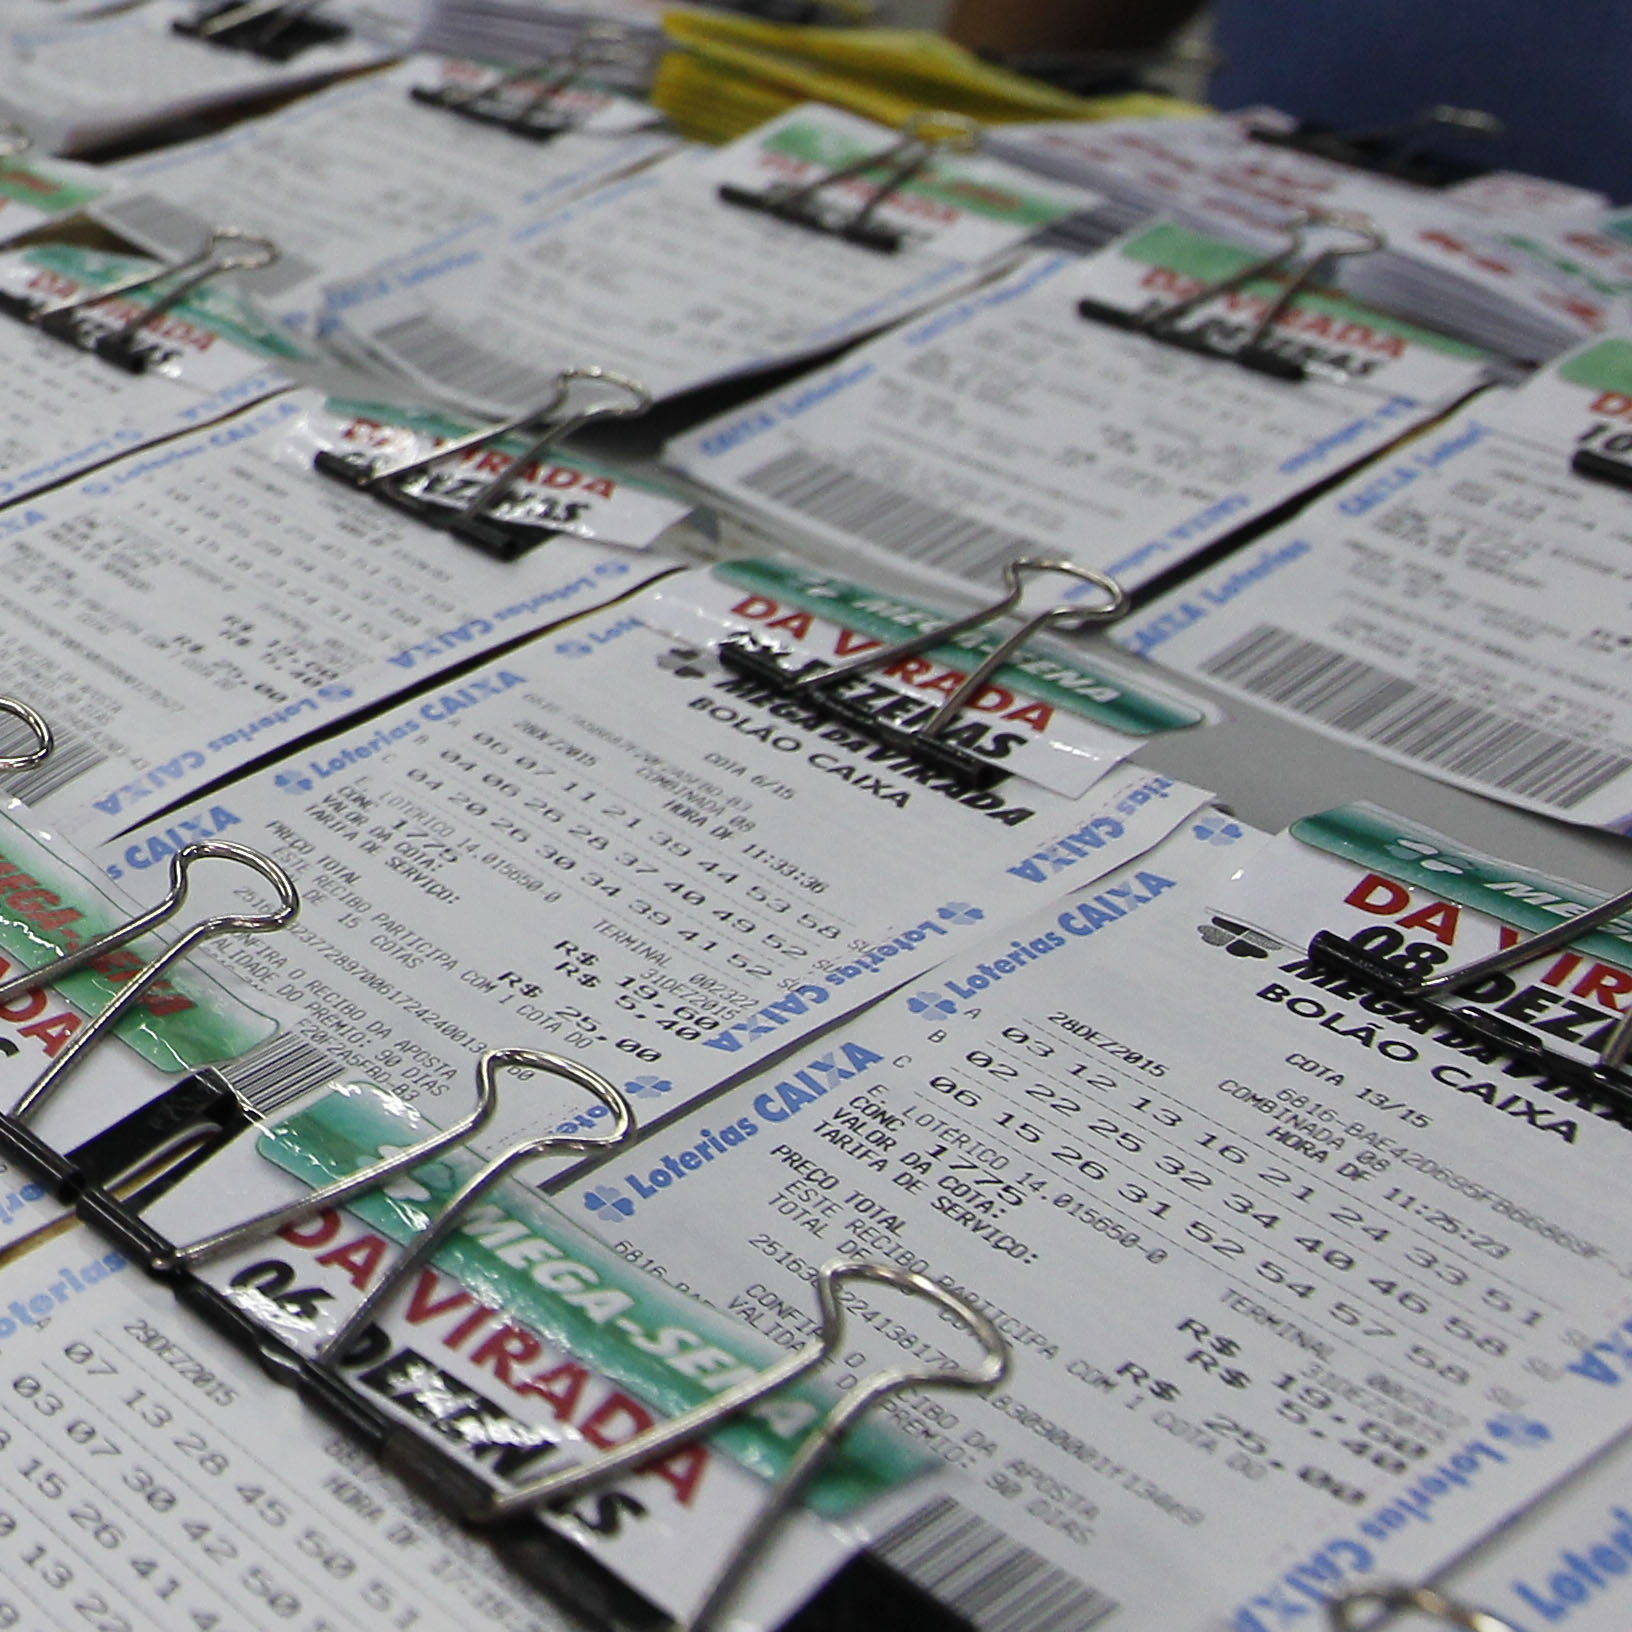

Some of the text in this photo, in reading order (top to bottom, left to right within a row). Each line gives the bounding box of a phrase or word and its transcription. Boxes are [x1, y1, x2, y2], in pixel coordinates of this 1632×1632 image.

[731, 594, 817, 641] DA
[686, 694, 912, 809] BOLÃO CAIXA
[741, 843, 830, 894] 11:33:36
[1343, 873, 1463, 946] DA
[496, 970, 663, 1063] R$ 25,00
[553, 940, 721, 1031] R$ 19,60
[554, 961, 702, 1041] R$ 5,40
[703, 920, 948, 1053] Loterias CAIXA
[1255, 982, 1578, 1145] BOLÃO CAIXA
[1284, 1053, 1433, 1129] COTA 13/15
[624, 1042, 884, 1199] Loterias CAIXA
[832, 1106, 1007, 1219] VALOR DA COTA:
[848, 1095, 1028, 1207] CONC 1775
[1047, 1011, 1511, 1260] 28DEZ2015 HORA DF 11:25:23
[1218, 1079, 1392, 1173] COMBINADA 08
[769, 1144, 907, 1238] PREÇO TOTAL
[812, 1119, 1039, 1264] TARIFA DE SERVIÇO:
[1001, 1026, 1056, 1058] 03
[1066, 1063, 1118, 1093] 12
[1129, 1096, 1184, 1128] 13
[1194, 1132, 1250, 1164] 16
[1257, 1166, 1315, 1204] 21
[1328, 1206, 1391, 1243] 24
[1404, 1246, 1470, 1287] 33
[1480, 1287, 1543, 1328] 51
[276, 1206, 712, 1507] DA VIRADA
